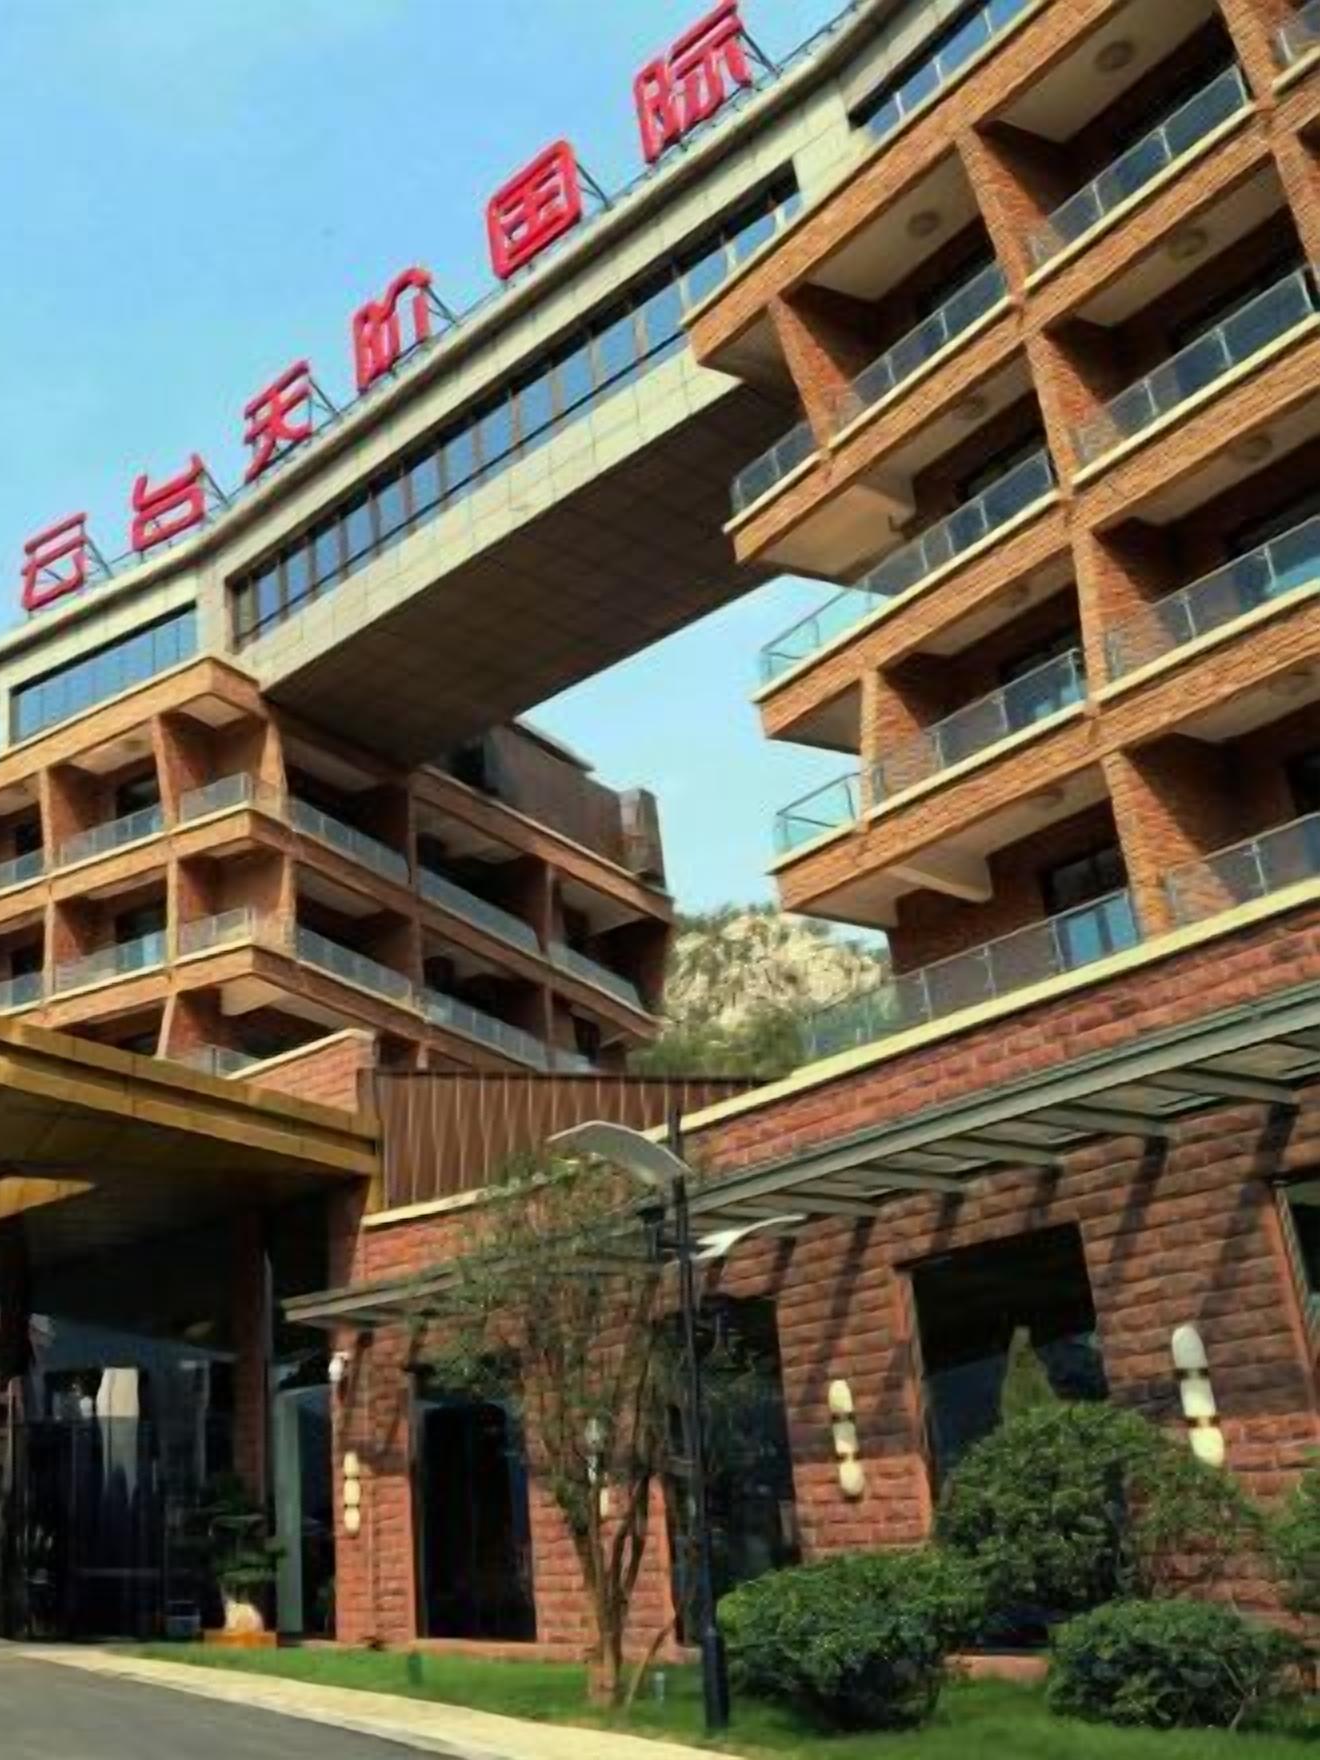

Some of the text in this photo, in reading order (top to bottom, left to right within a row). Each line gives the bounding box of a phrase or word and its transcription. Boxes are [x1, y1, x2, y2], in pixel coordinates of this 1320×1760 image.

[21, 0, 751, 611] 云台天阶国际
